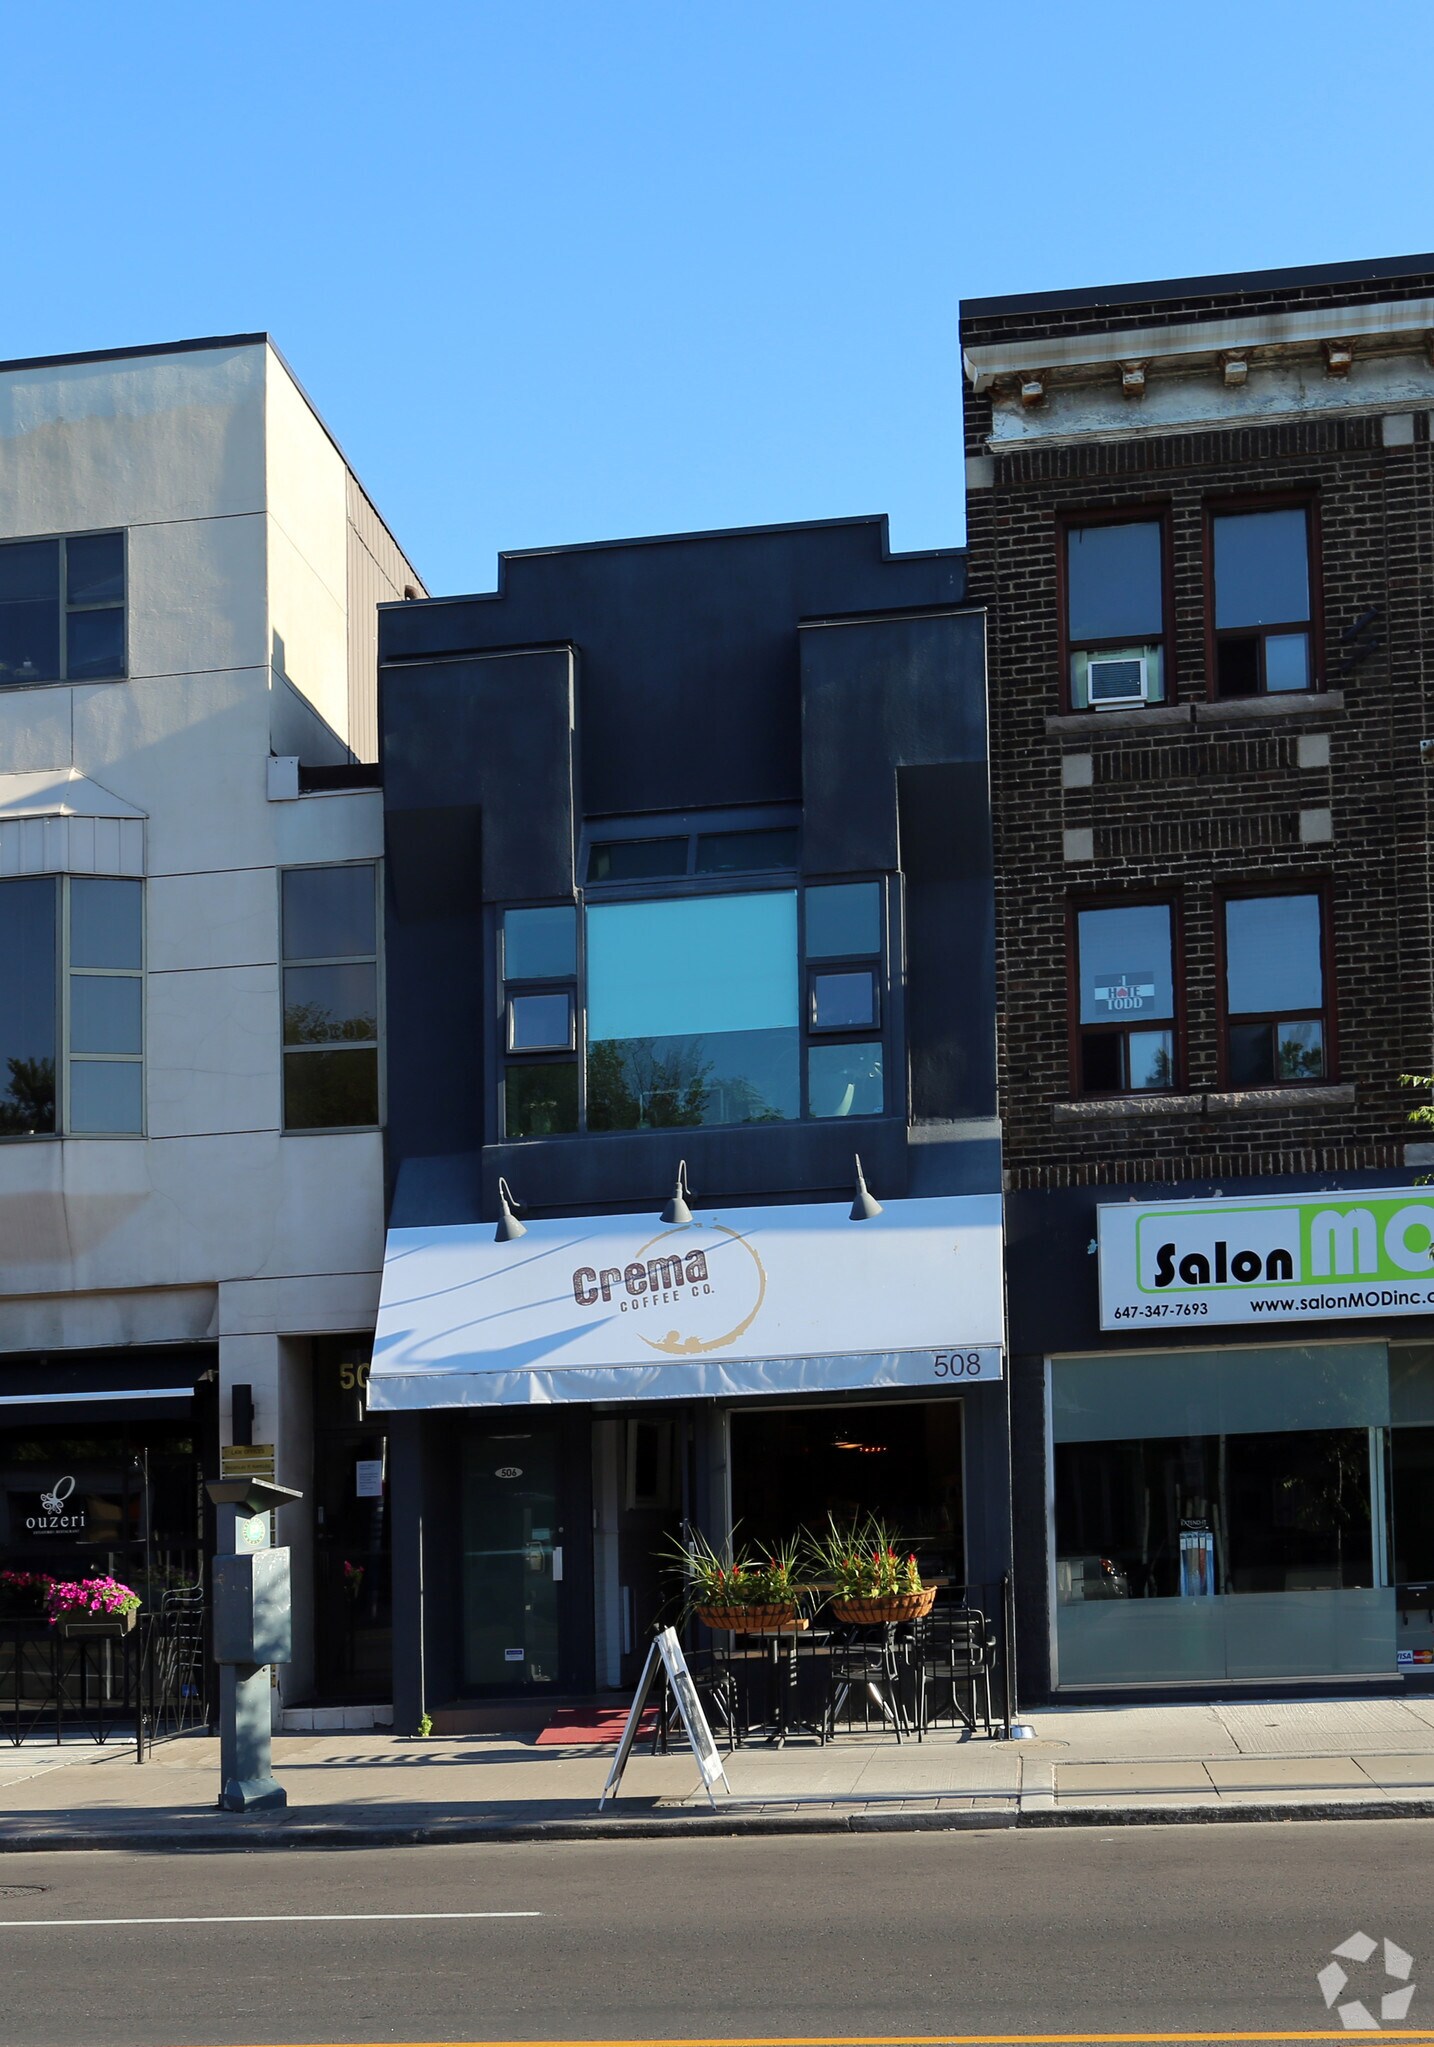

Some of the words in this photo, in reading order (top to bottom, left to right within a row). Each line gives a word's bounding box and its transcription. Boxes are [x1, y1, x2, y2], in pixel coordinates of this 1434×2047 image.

[1122, 975, 1126, 986] I
[1106, 997, 1143, 1010] TODD
[1154, 1241, 1293, 1288] Salon
[572, 1249, 708, 1306] Crema
[620, 1290, 680, 1312] COFFEE
[691, 1283, 715, 1297] CO.
[1114, 1303, 1208, 1319] 647-347-7693
[934, 1353, 981, 1377] 508
[501, 1469, 517, 1477] 506
[26, 1511, 85, 1529] ouzeri
